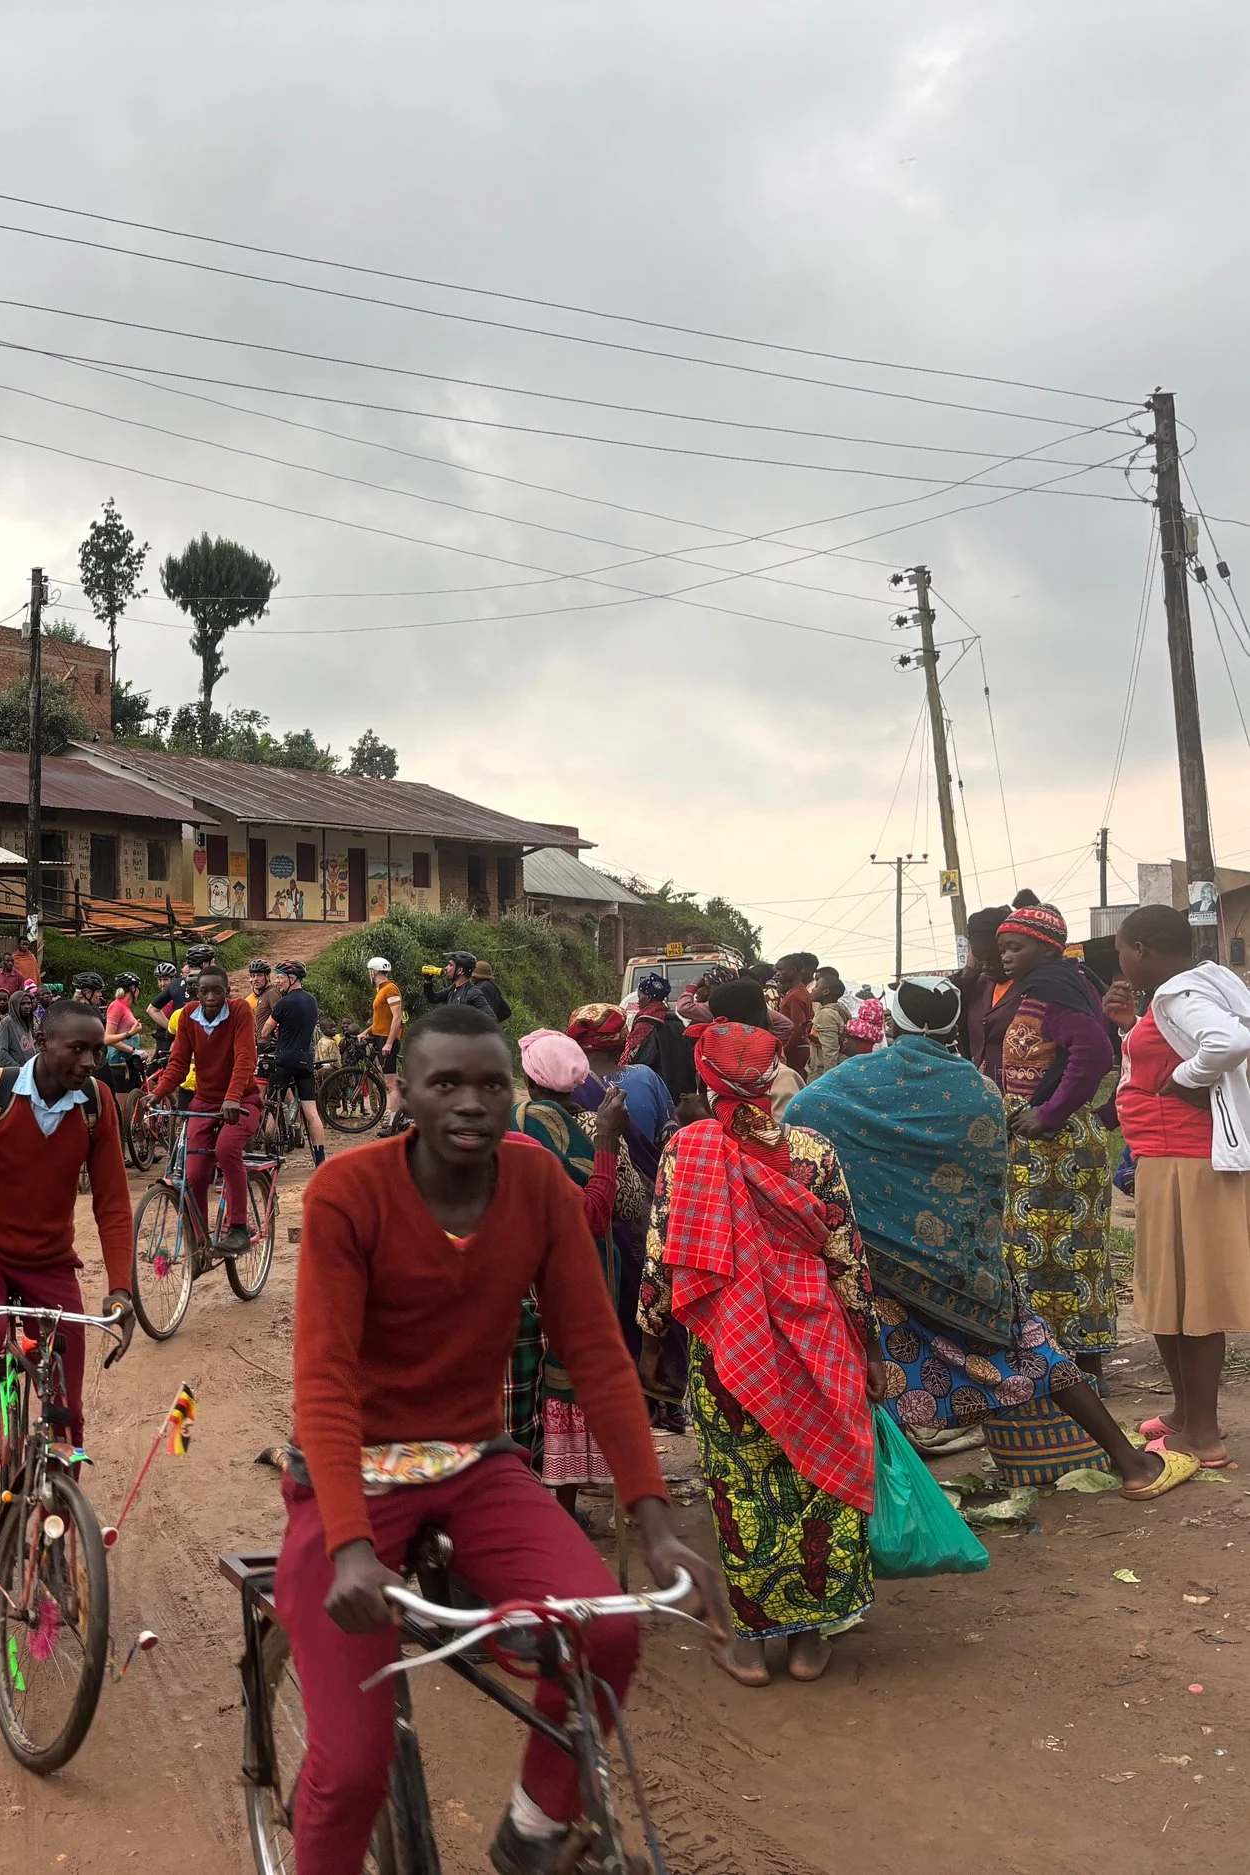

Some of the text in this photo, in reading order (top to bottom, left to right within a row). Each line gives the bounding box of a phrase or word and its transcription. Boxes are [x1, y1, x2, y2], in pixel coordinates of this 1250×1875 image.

[126, 888, 132, 900] 8
[139, 887, 144, 899] 9
[1022, 908, 1062, 927] YORK
